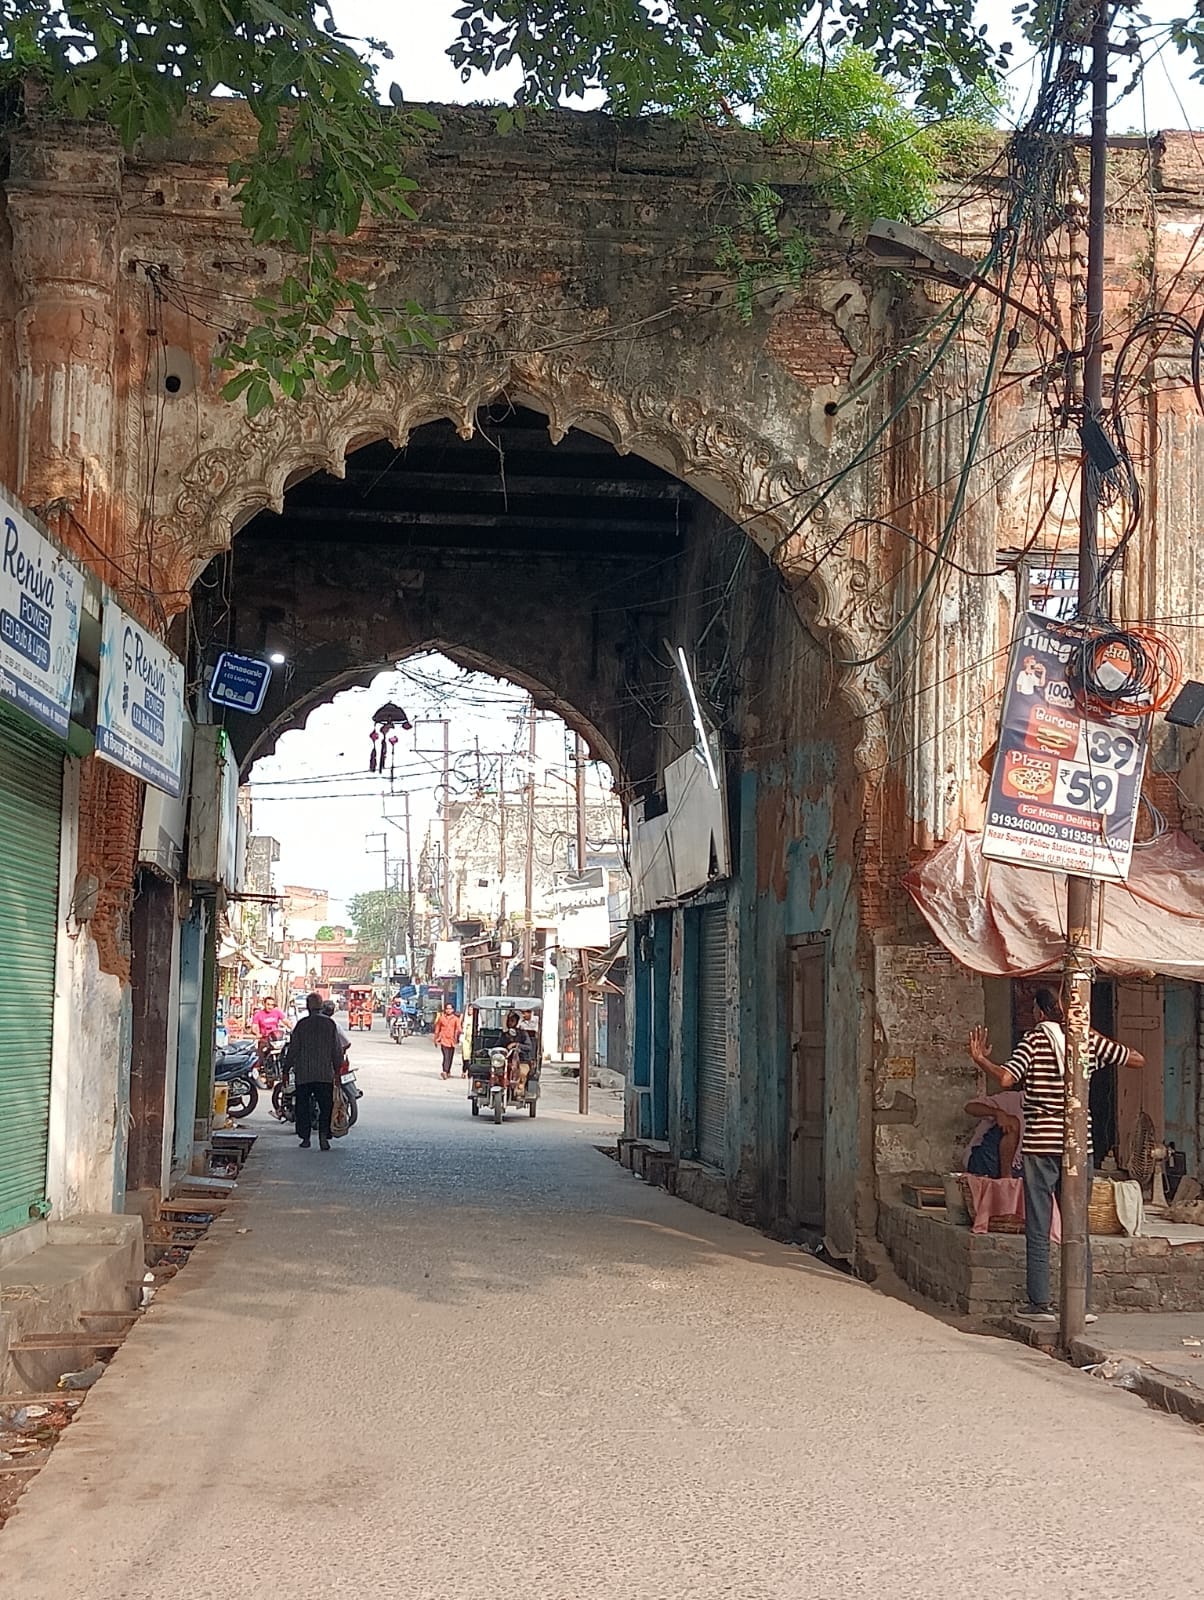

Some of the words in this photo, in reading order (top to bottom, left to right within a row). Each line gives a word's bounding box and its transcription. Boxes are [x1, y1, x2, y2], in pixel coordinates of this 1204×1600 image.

[3, 517, 54, 610] Reniva
[1, 611, 15, 639] LED
[14, 623, 27, 649] Bulb
[22, 601, 49, 635] POWER
[135, 632, 166, 697] Reniva
[223, 660, 263, 679] Panasonic
[1035, 707, 1079, 730] Burger
[1012, 751, 1052, 771] Pizza
[1022, 804, 1038, 815] For
[1038, 807, 1064, 821] Home
[1066, 813, 1101, 831] Delivery
